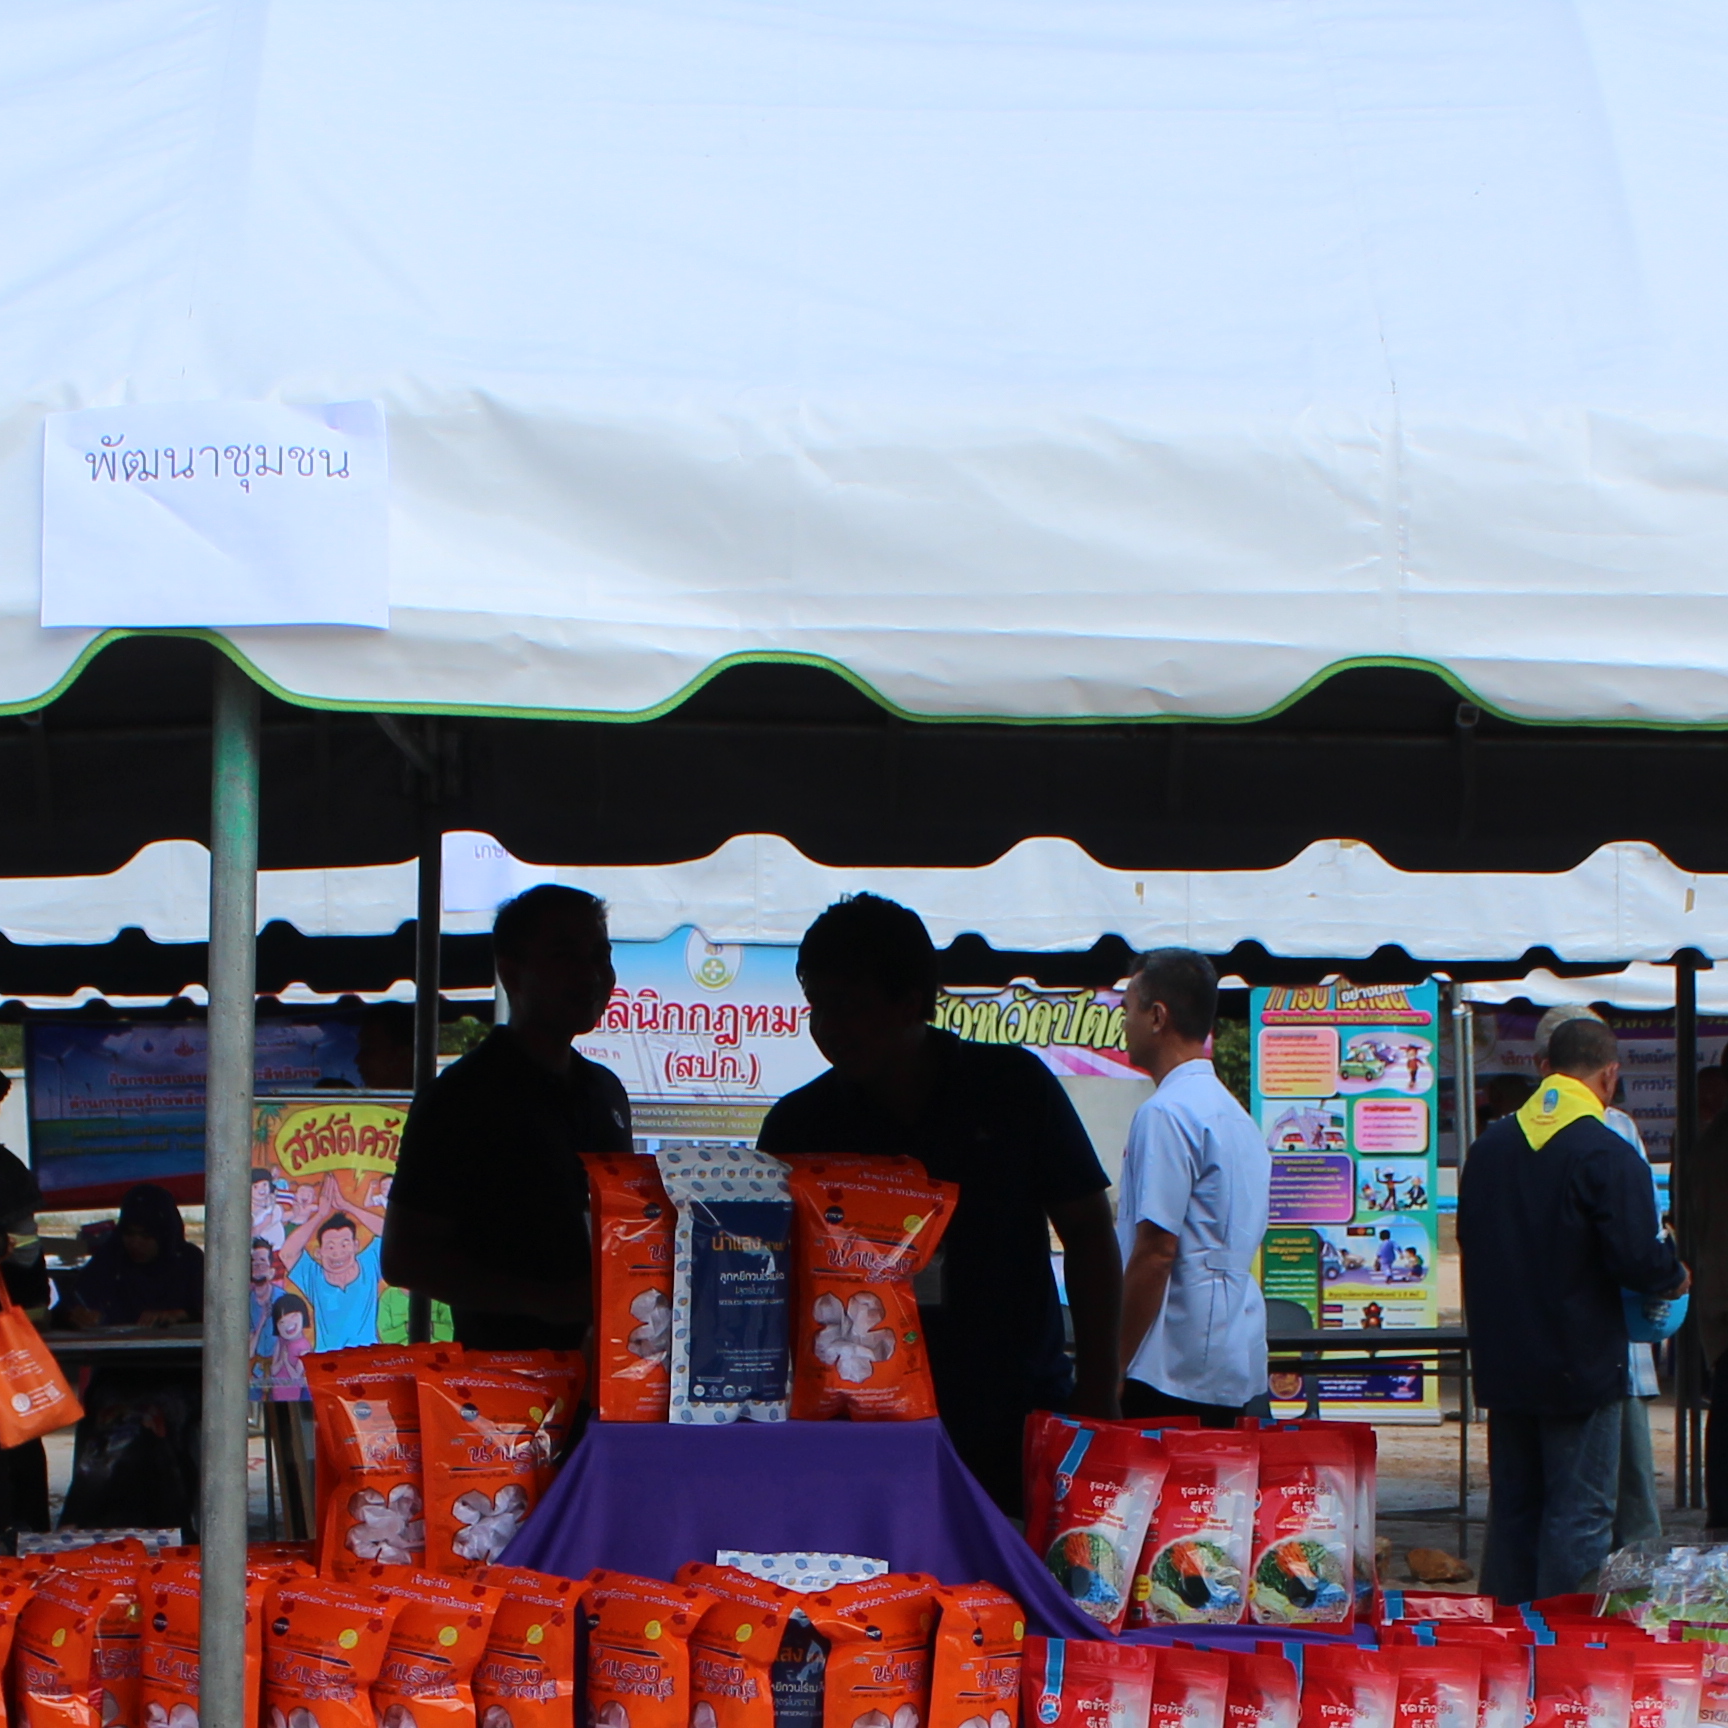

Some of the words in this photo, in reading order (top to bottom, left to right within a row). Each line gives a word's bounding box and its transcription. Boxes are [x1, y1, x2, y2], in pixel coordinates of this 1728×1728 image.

[84, 434, 351, 493] พัฒนาชุมชน
[594, 988, 813, 1045] ลินิกกฎหม
[664, 1050, 759, 1086] (สปก.)
